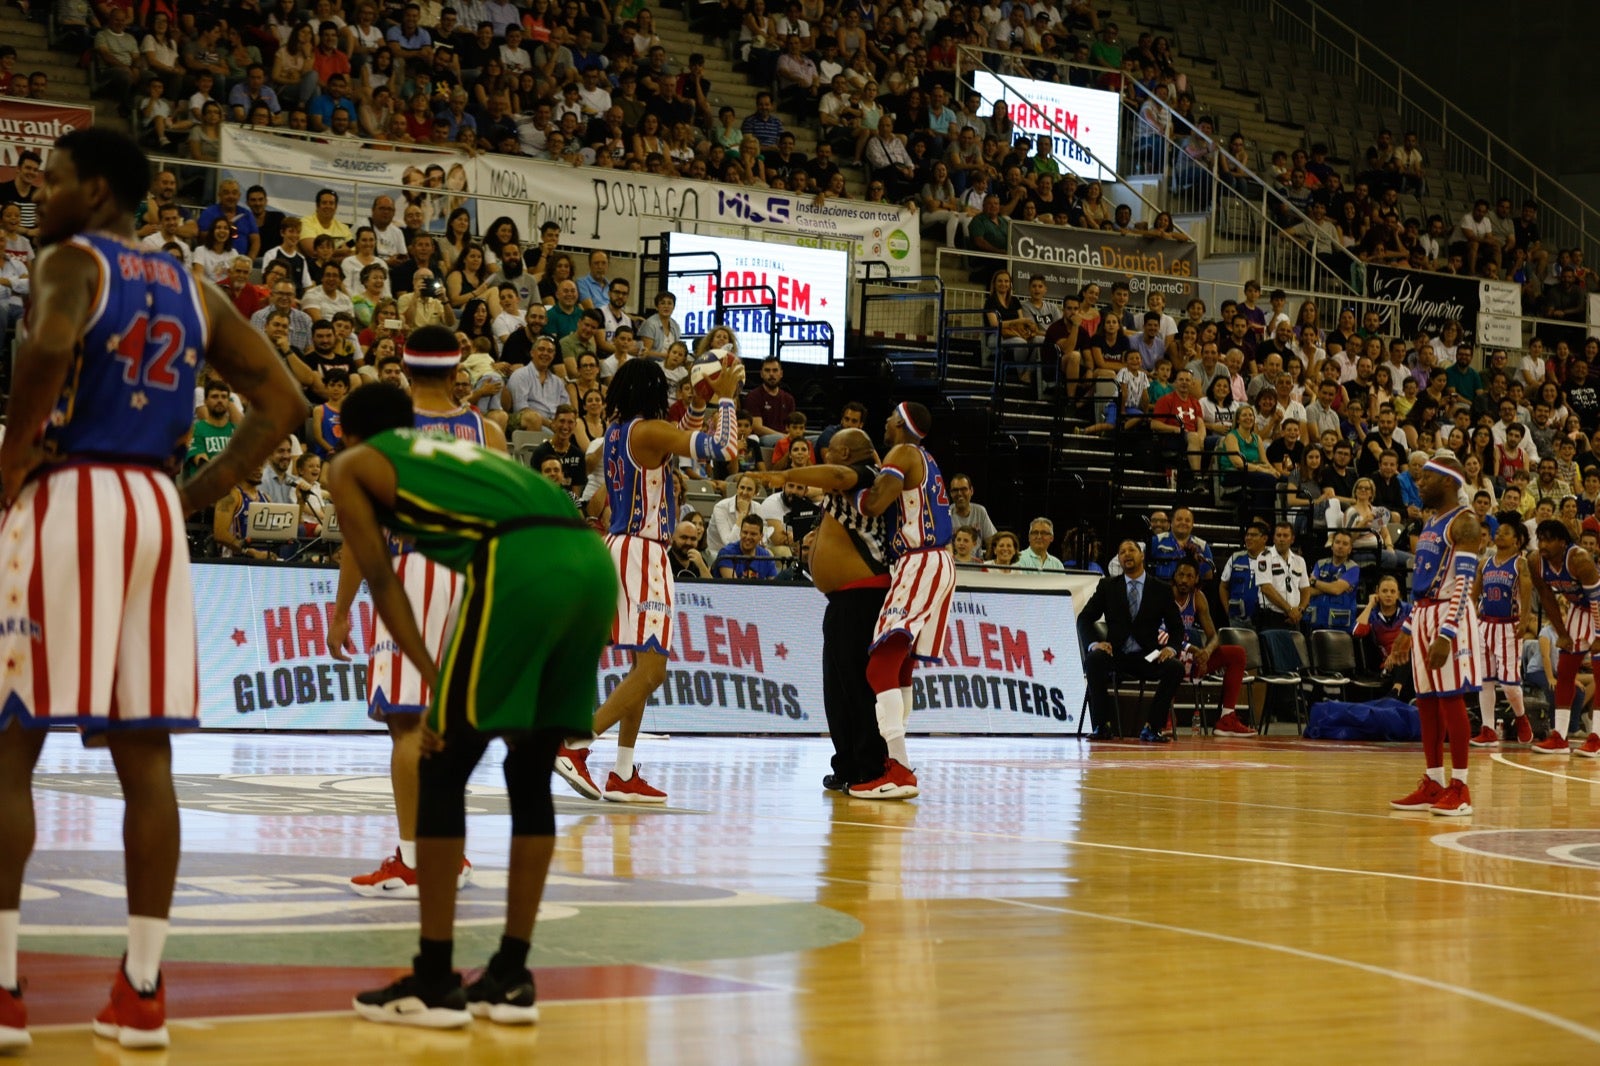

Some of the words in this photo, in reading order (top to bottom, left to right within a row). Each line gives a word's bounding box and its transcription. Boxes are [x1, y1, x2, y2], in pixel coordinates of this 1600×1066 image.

[332, 158, 387, 172] SANDERS
[489, 169, 528, 200] MODA
[592, 178, 699, 239] PORTAGO
[795, 200, 857, 218] Instalaciones
[859, 211, 876, 221] con
[877, 210, 900, 223] total
[795, 215, 838, 231] Garantía
[735, 257, 748, 267] THE
[752, 258, 785, 272] ORIGINAL
[1017, 237, 1192, 278] GranadaDigital.es
[707, 271, 811, 316] HARLEM
[1129, 278, 1191, 294] @dporteGD
[115, 310, 186, 392] 42
[952, 602, 988, 617] IGINAL
[233, 664, 368, 714] GLOBETR
[912, 674, 1067, 722] BETROTTERS
